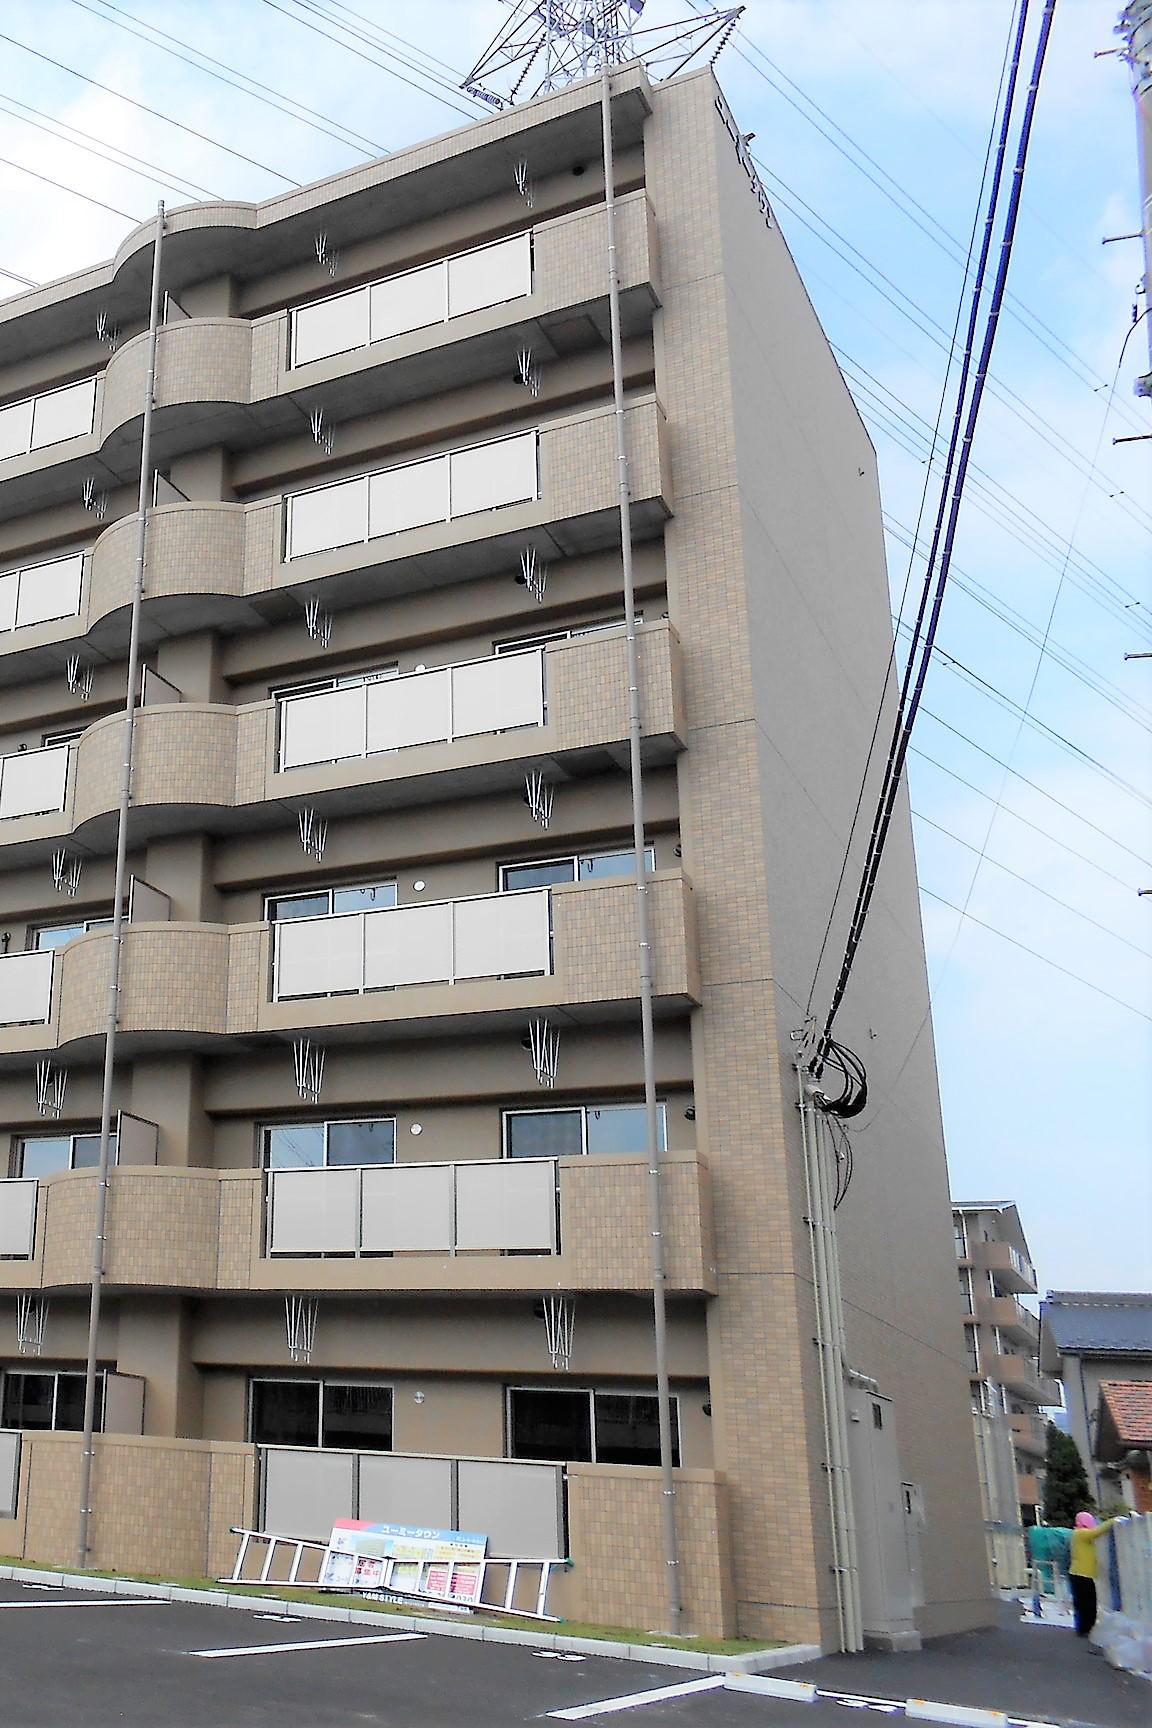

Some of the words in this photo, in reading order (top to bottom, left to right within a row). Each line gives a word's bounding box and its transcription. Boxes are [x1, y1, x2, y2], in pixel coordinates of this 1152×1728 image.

[382, 1524, 440, 1539] ユーミータウン
